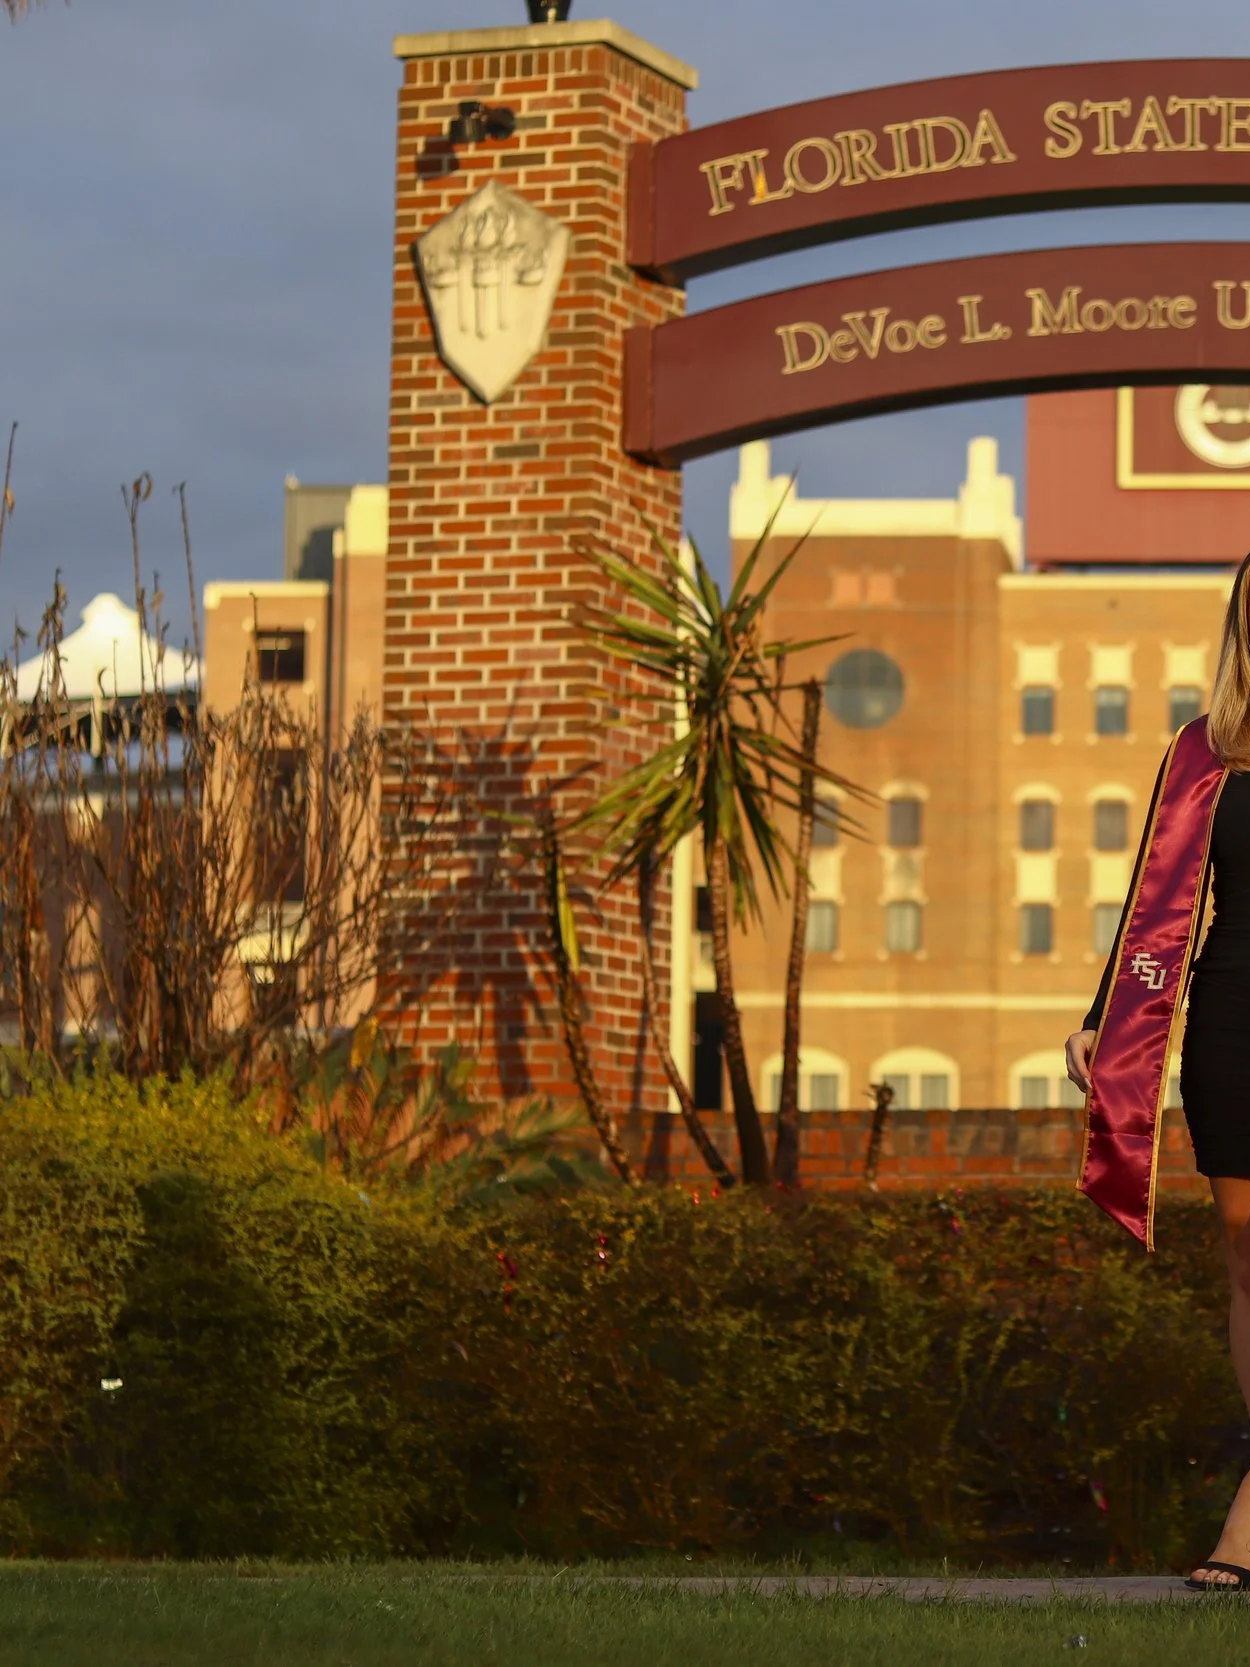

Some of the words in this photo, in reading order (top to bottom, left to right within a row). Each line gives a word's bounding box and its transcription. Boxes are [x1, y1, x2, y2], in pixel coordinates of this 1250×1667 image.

[699, 109, 1017, 217] FLORIDA
[775, 307, 947, 375] DeVoe
[958, 295, 1011, 345] L.
[1025, 286, 1197, 338] Moore
[1129, 953, 1166, 990] FSU
